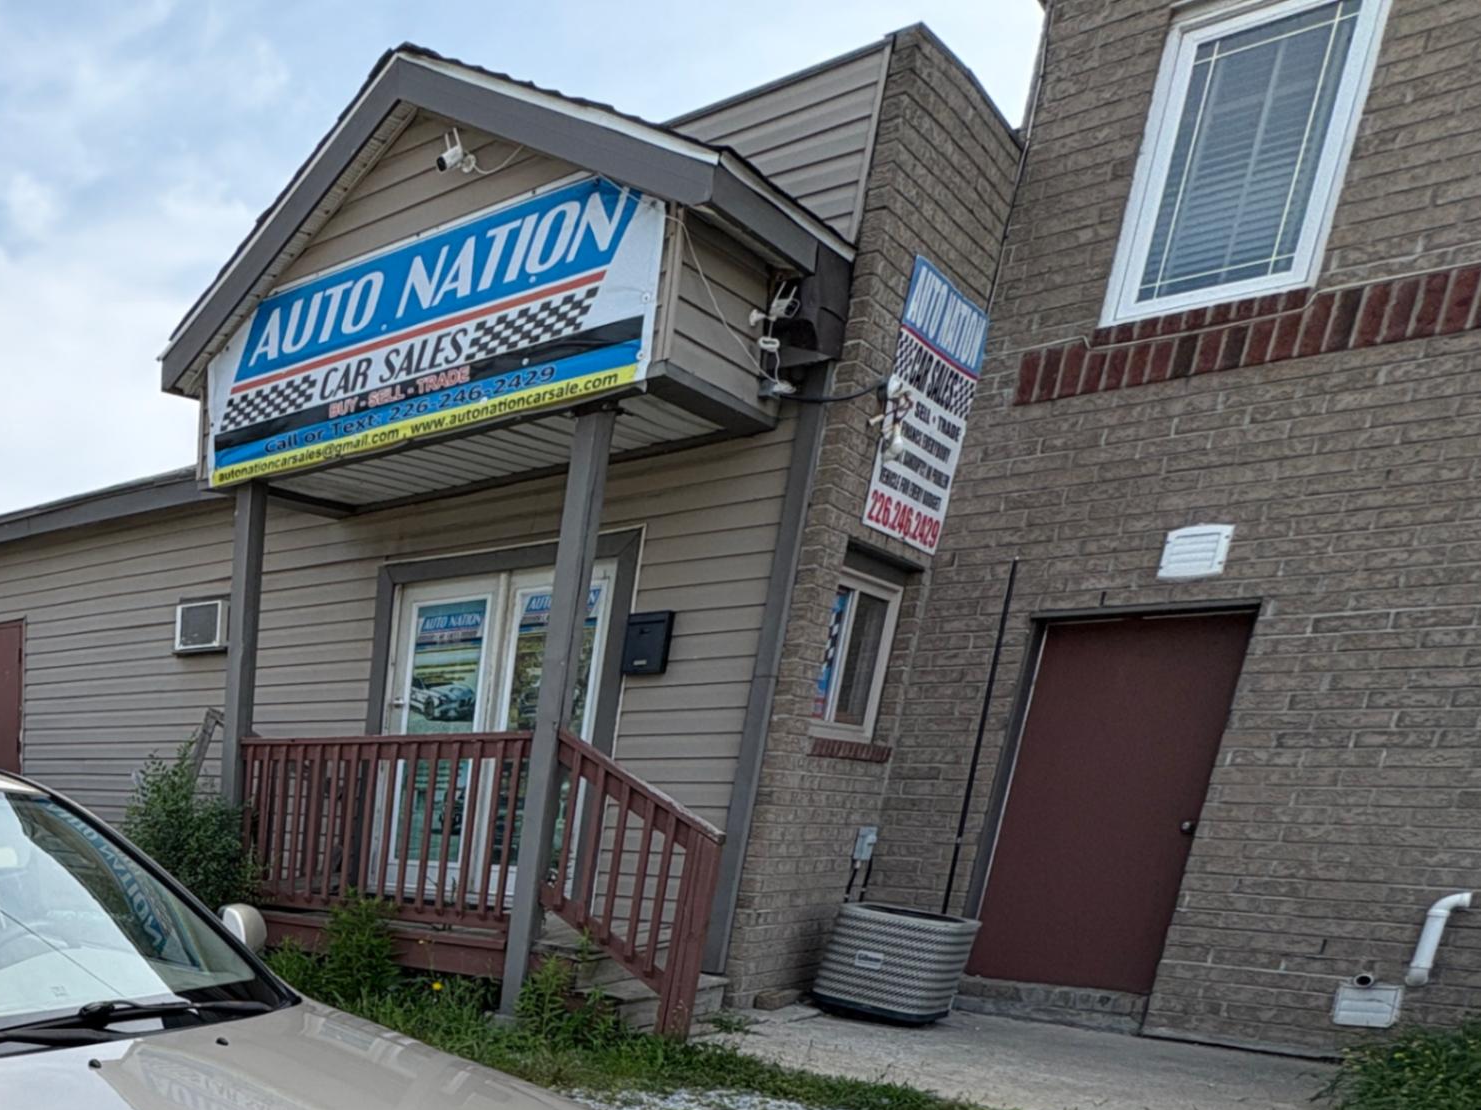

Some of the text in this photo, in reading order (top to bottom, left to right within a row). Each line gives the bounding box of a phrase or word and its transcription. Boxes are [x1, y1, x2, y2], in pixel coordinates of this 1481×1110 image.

[248, 187, 629, 367] AUTO NATION
[906, 265, 988, 369] AUTO NATION
[319, 327, 468, 400] CAR SALES
[328, 365, 471, 419] BUY SELL TRADE
[909, 345, 959, 411] CAR SALES
[218, 372, 619, 482] autonationcarsales@gmail.com www.autonationcarsale.com
[264, 366, 557, 455] Call or Text: 226-246-2429
[867, 489, 941, 549] 226.246.2429
